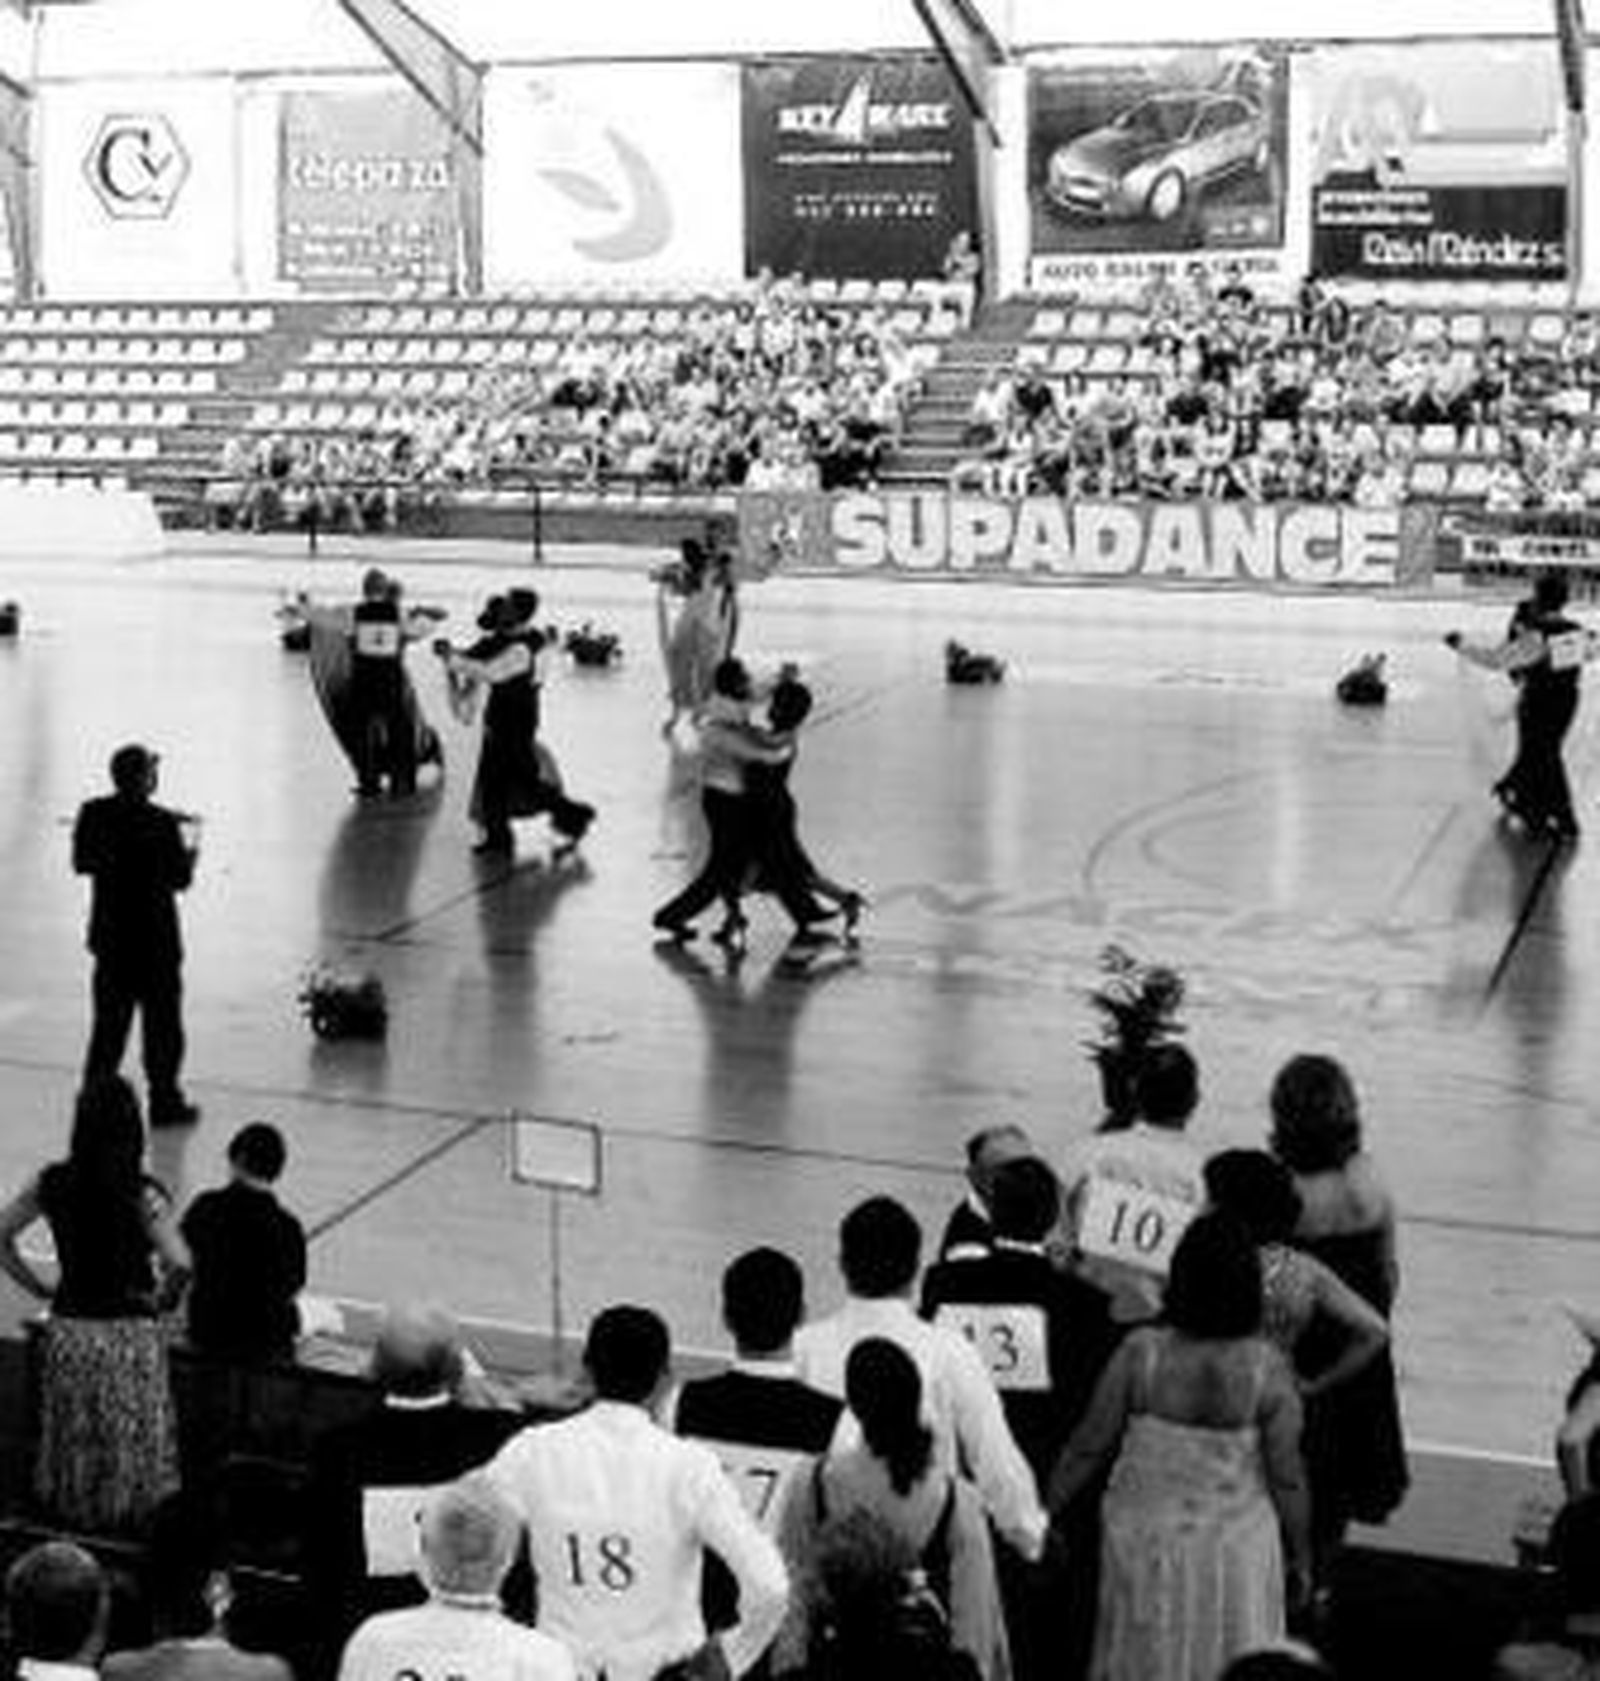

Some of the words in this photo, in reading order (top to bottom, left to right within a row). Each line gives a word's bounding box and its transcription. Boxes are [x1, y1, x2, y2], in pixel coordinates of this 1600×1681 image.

[831, 491, 1402, 583] SUPADANCE
[1107, 1200, 1164, 1254] 10
[564, 1532, 635, 1593] 18
